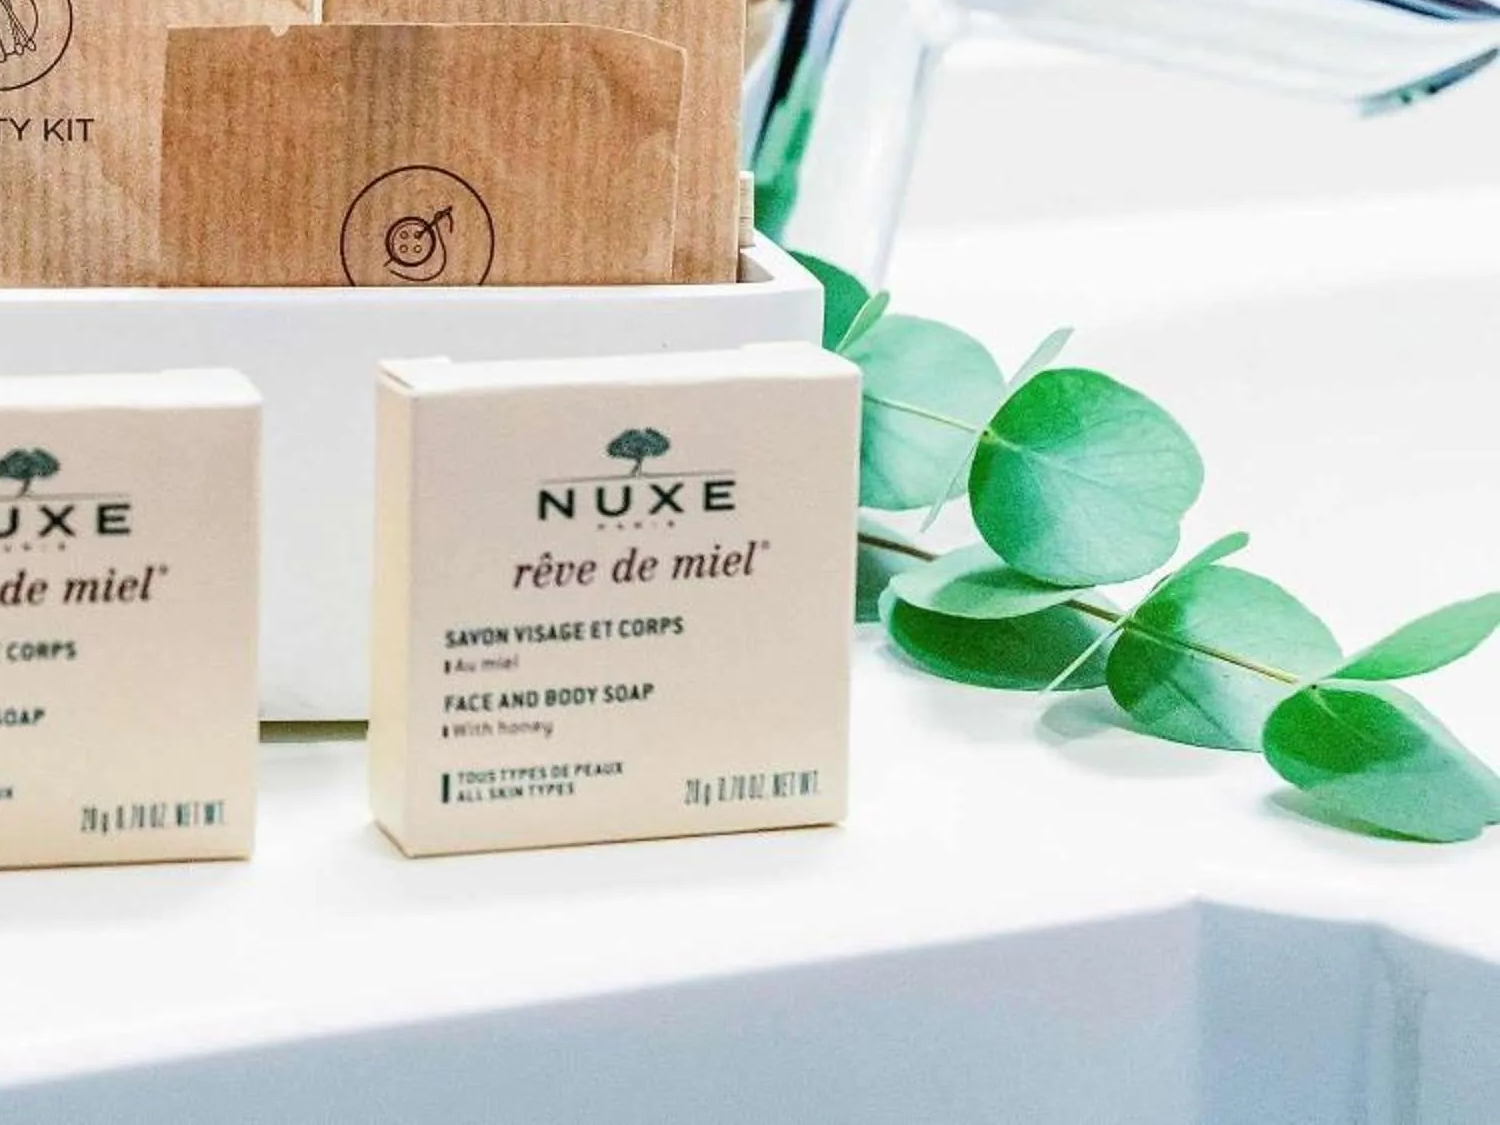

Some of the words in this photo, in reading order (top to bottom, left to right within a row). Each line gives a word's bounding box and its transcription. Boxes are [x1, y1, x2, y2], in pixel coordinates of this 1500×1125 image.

[43, 118, 95, 142] KIT
[537, 479, 736, 521] NUXE
[513, 551, 597, 588] rêve
[612, 547, 659, 584] de
[0, 568, 48, 606] de
[445, 627, 509, 649] SAVON
[514, 622, 584, 644] VISAGE
[591, 620, 613, 640] ET
[618, 616, 685, 639] CORPS
[6, 640, 78, 662] CORPS
[444, 693, 492, 713] FACE
[498, 690, 539, 710] AND
[544, 687, 598, 708] BODY
[602, 682, 655, 703] SOAP
[528, 782, 575, 797] TYPES
